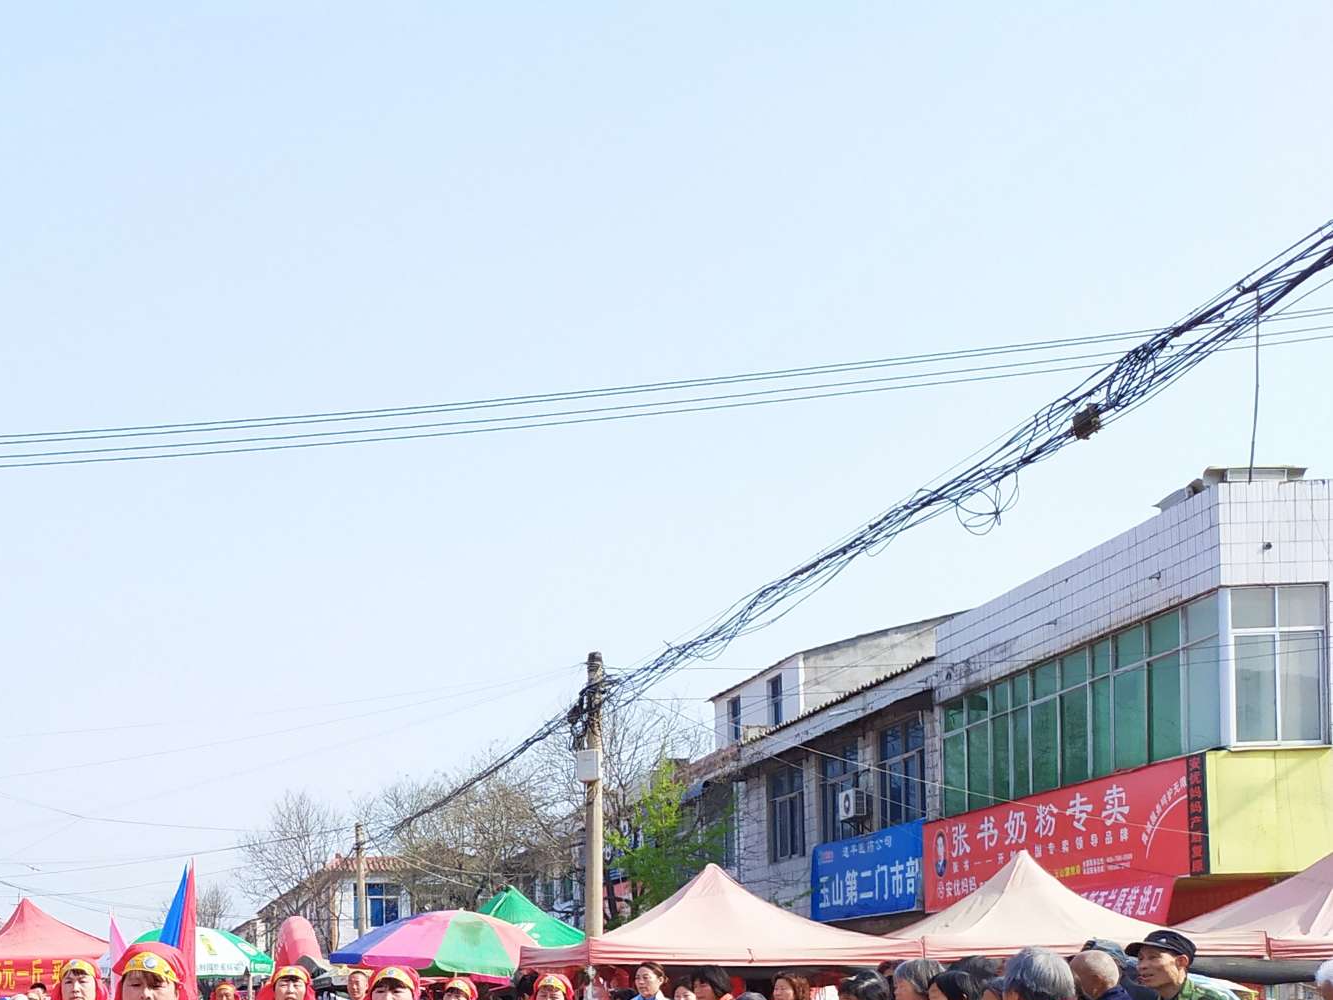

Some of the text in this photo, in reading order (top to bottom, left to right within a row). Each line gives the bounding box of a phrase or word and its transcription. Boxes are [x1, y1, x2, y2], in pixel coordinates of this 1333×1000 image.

[951, 784, 1130, 858] 张书奶粉专卖
[818, 856, 921, 908] 玉山第二门市部
